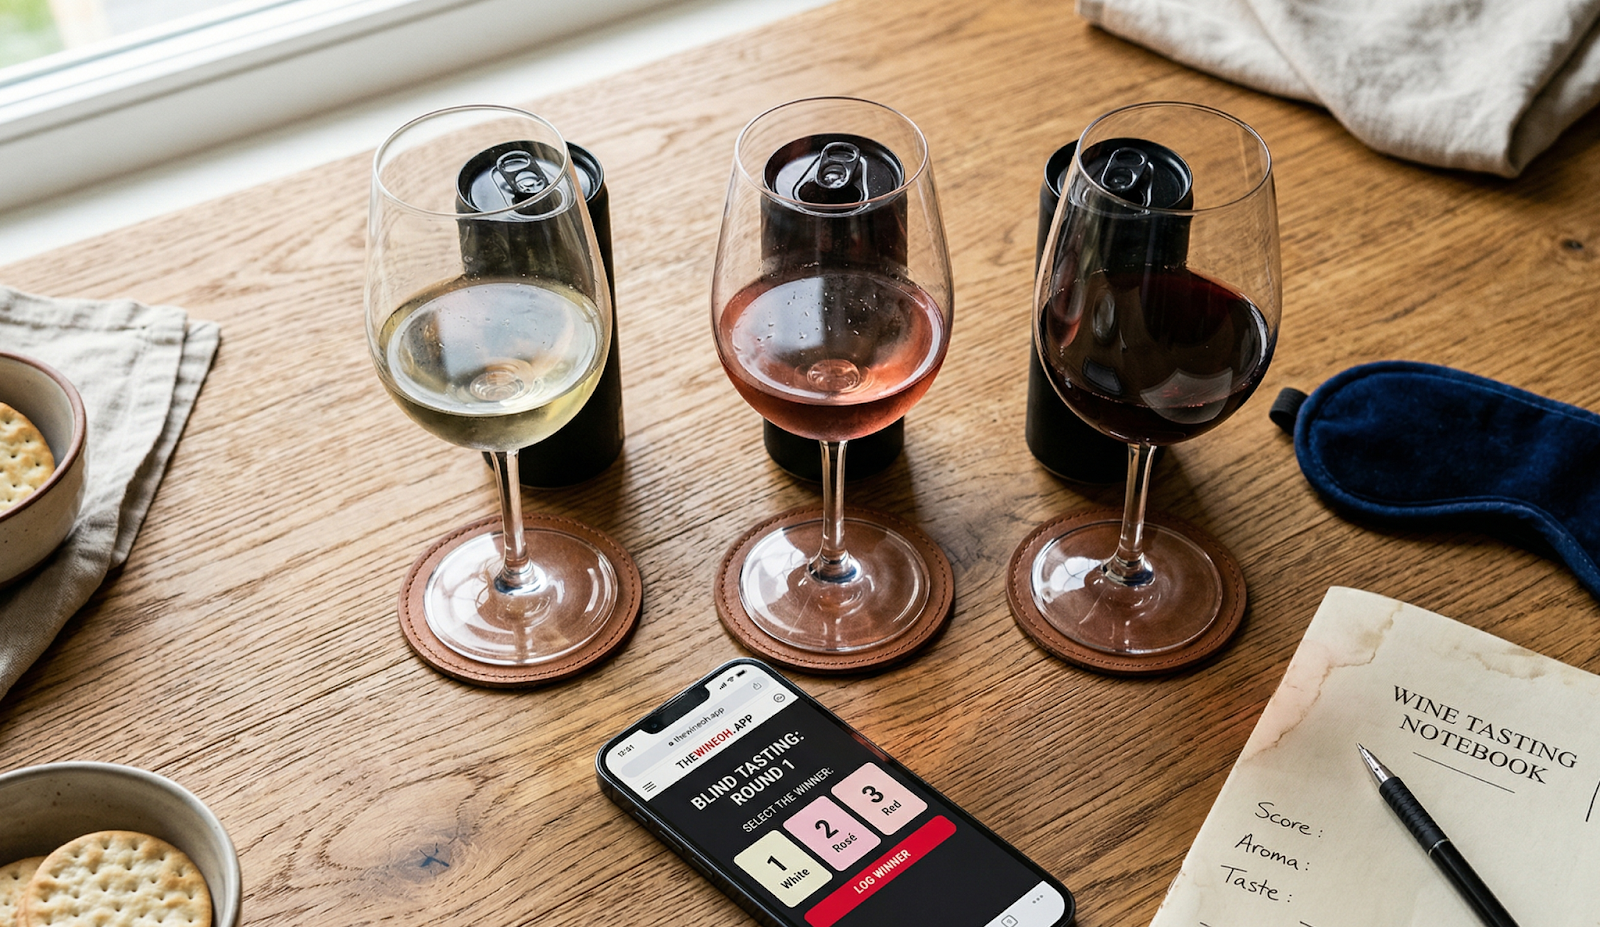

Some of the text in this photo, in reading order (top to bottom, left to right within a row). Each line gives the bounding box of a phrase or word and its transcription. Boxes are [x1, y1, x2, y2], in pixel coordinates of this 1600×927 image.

[675, 714, 753, 769] THEWINEOH.APP
[1394, 685, 1578, 769] WINE TASTING
[1399, 714, 1548, 784] NOTEBOOK
[690, 730, 805, 811] BLIND TASTING:
[730, 759, 795, 807] ROUND 1
[742, 767, 834, 833] SELECT THE WINNER:
[862, 784, 884, 804] 3
[881, 799, 902, 817] Red
[815, 819, 839, 839] 2
[832, 832, 858, 854] Rosé
[767, 855, 788, 872] 1
[780, 868, 810, 890] White
[853, 849, 911, 895] LOG WINNER
